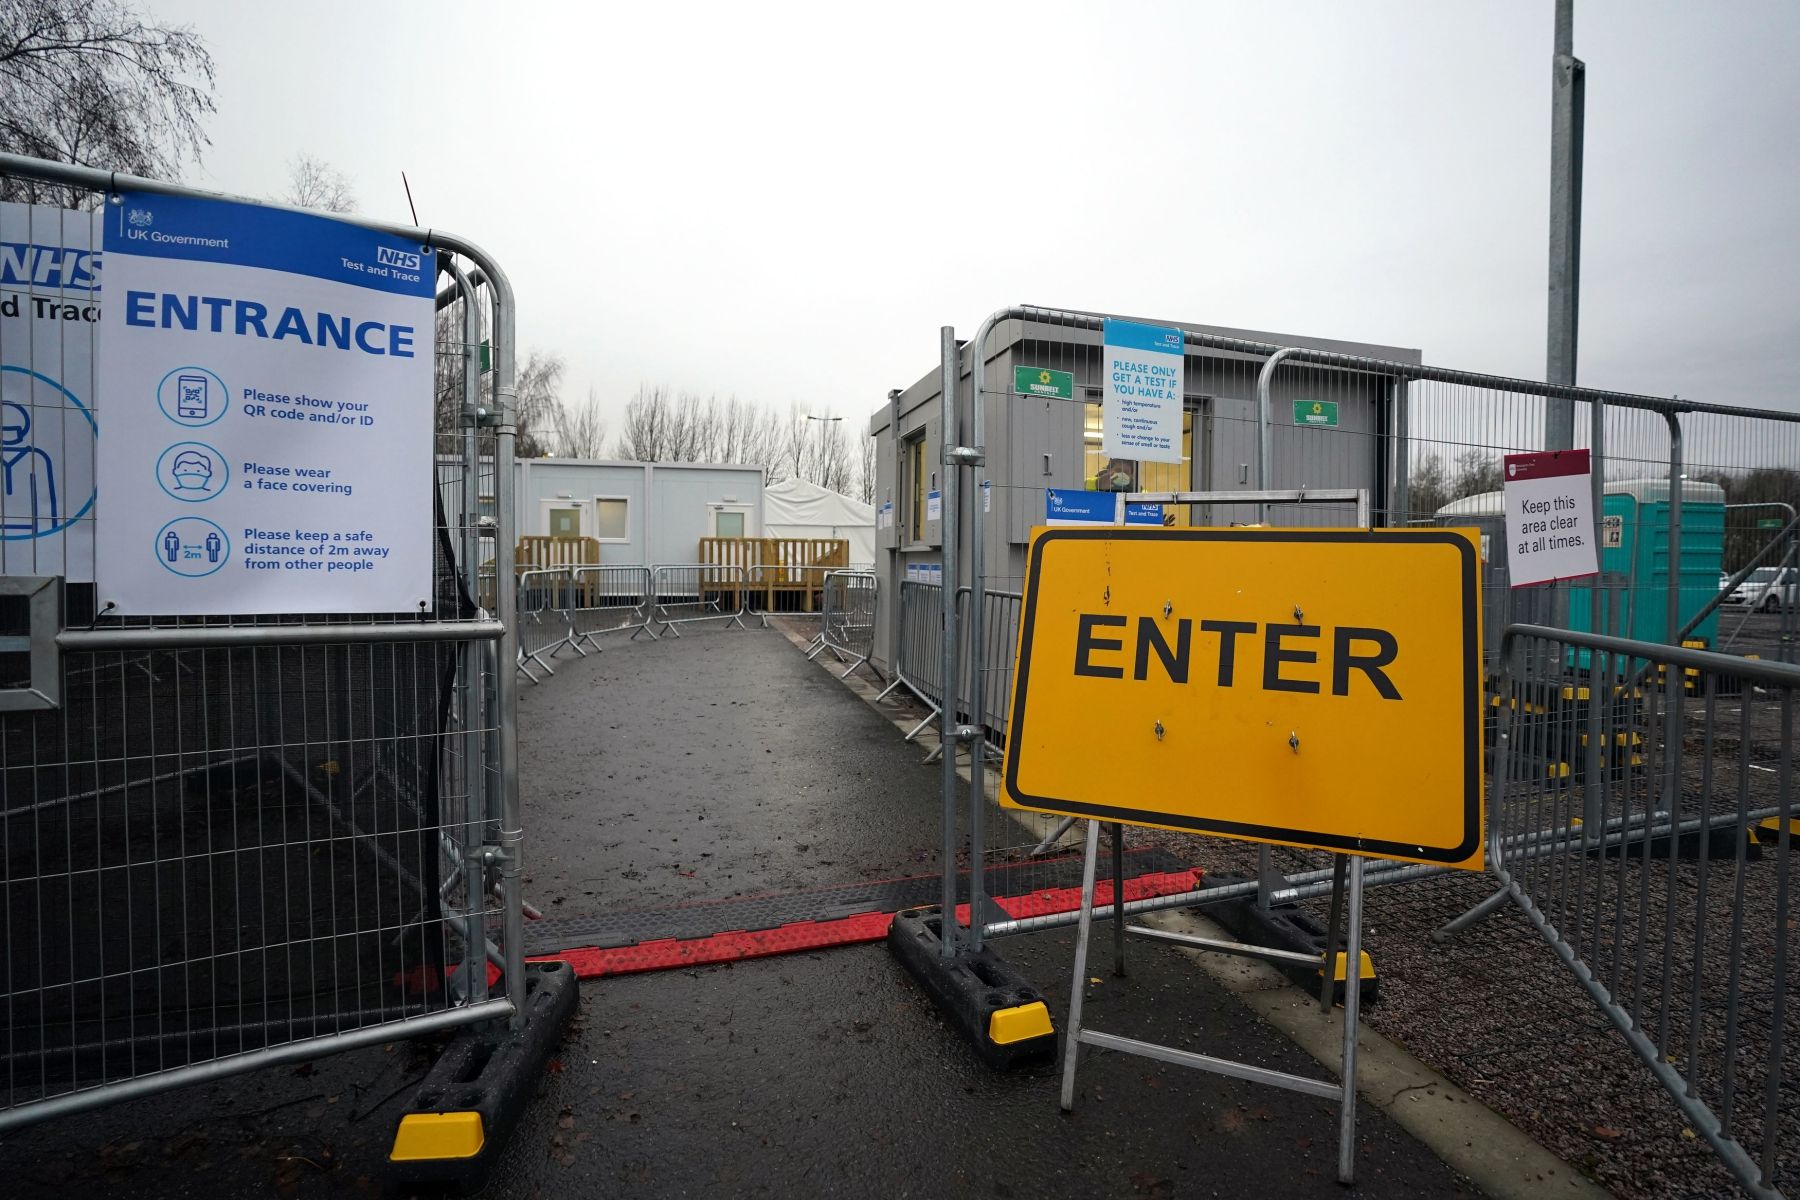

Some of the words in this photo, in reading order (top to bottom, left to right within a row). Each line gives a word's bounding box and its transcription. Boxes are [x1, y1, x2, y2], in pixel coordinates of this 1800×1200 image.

[127, 229, 148, 241] UK
[151, 231, 229, 248] Government
[0, 245, 102, 288] NHS
[379, 248, 418, 268] NHS
[341, 257, 365, 272] Test
[367, 265, 388, 277] and
[391, 269, 420, 283] Trace
[31, 297, 101, 323] Trac
[126, 290, 414, 358] ENTRANCE
[1113, 361, 1148, 373] PLEASE
[1151, 366, 1176, 377] ONLY
[1030, 384, 1059, 393] SUNBELT
[1112, 372, 1131, 383] GET
[1135, 376, 1141, 385] A
[1144, 376, 1166, 387] TEST
[1169, 379, 1177, 388] IF
[244, 389, 290, 404] Please
[295, 395, 333, 409] show
[337, 401, 369, 412] your
[1114, 384, 1135, 395] YOU
[1138, 388, 1163, 398] HAVE
[1166, 391, 1176, 400] A:
[244, 404, 266, 417] QR
[270, 409, 305, 421] code
[309, 413, 356, 425] and/or
[360, 415, 374, 426] ID
[244, 463, 290, 477] Please
[295, 468, 331, 478] wear
[244, 480, 252, 489] a
[257, 478, 288, 490] face
[292, 482, 352, 496] covering
[1522, 499, 1550, 515] Keep
[1553, 495, 1575, 511] this
[1522, 520, 1547, 534] area
[1550, 516, 1578, 531] clear
[244, 528, 290, 540] Please
[295, 530, 329, 543] keep
[333, 533, 341, 541] a
[345, 530, 373, 541] safe
[1518, 541, 1529, 554] at
[1532, 537, 1546, 552] all
[1549, 535, 1585, 550] times.
[184, 550, 202, 559] 2m
[244, 543, 305, 555] distance
[309, 544, 324, 555] of
[328, 545, 349, 556] 2m
[353, 547, 389, 558] away
[244, 558, 280, 570] from
[285, 559, 323, 570] other
[327, 559, 374, 572] people
[1074, 613, 1403, 700] ENTER
